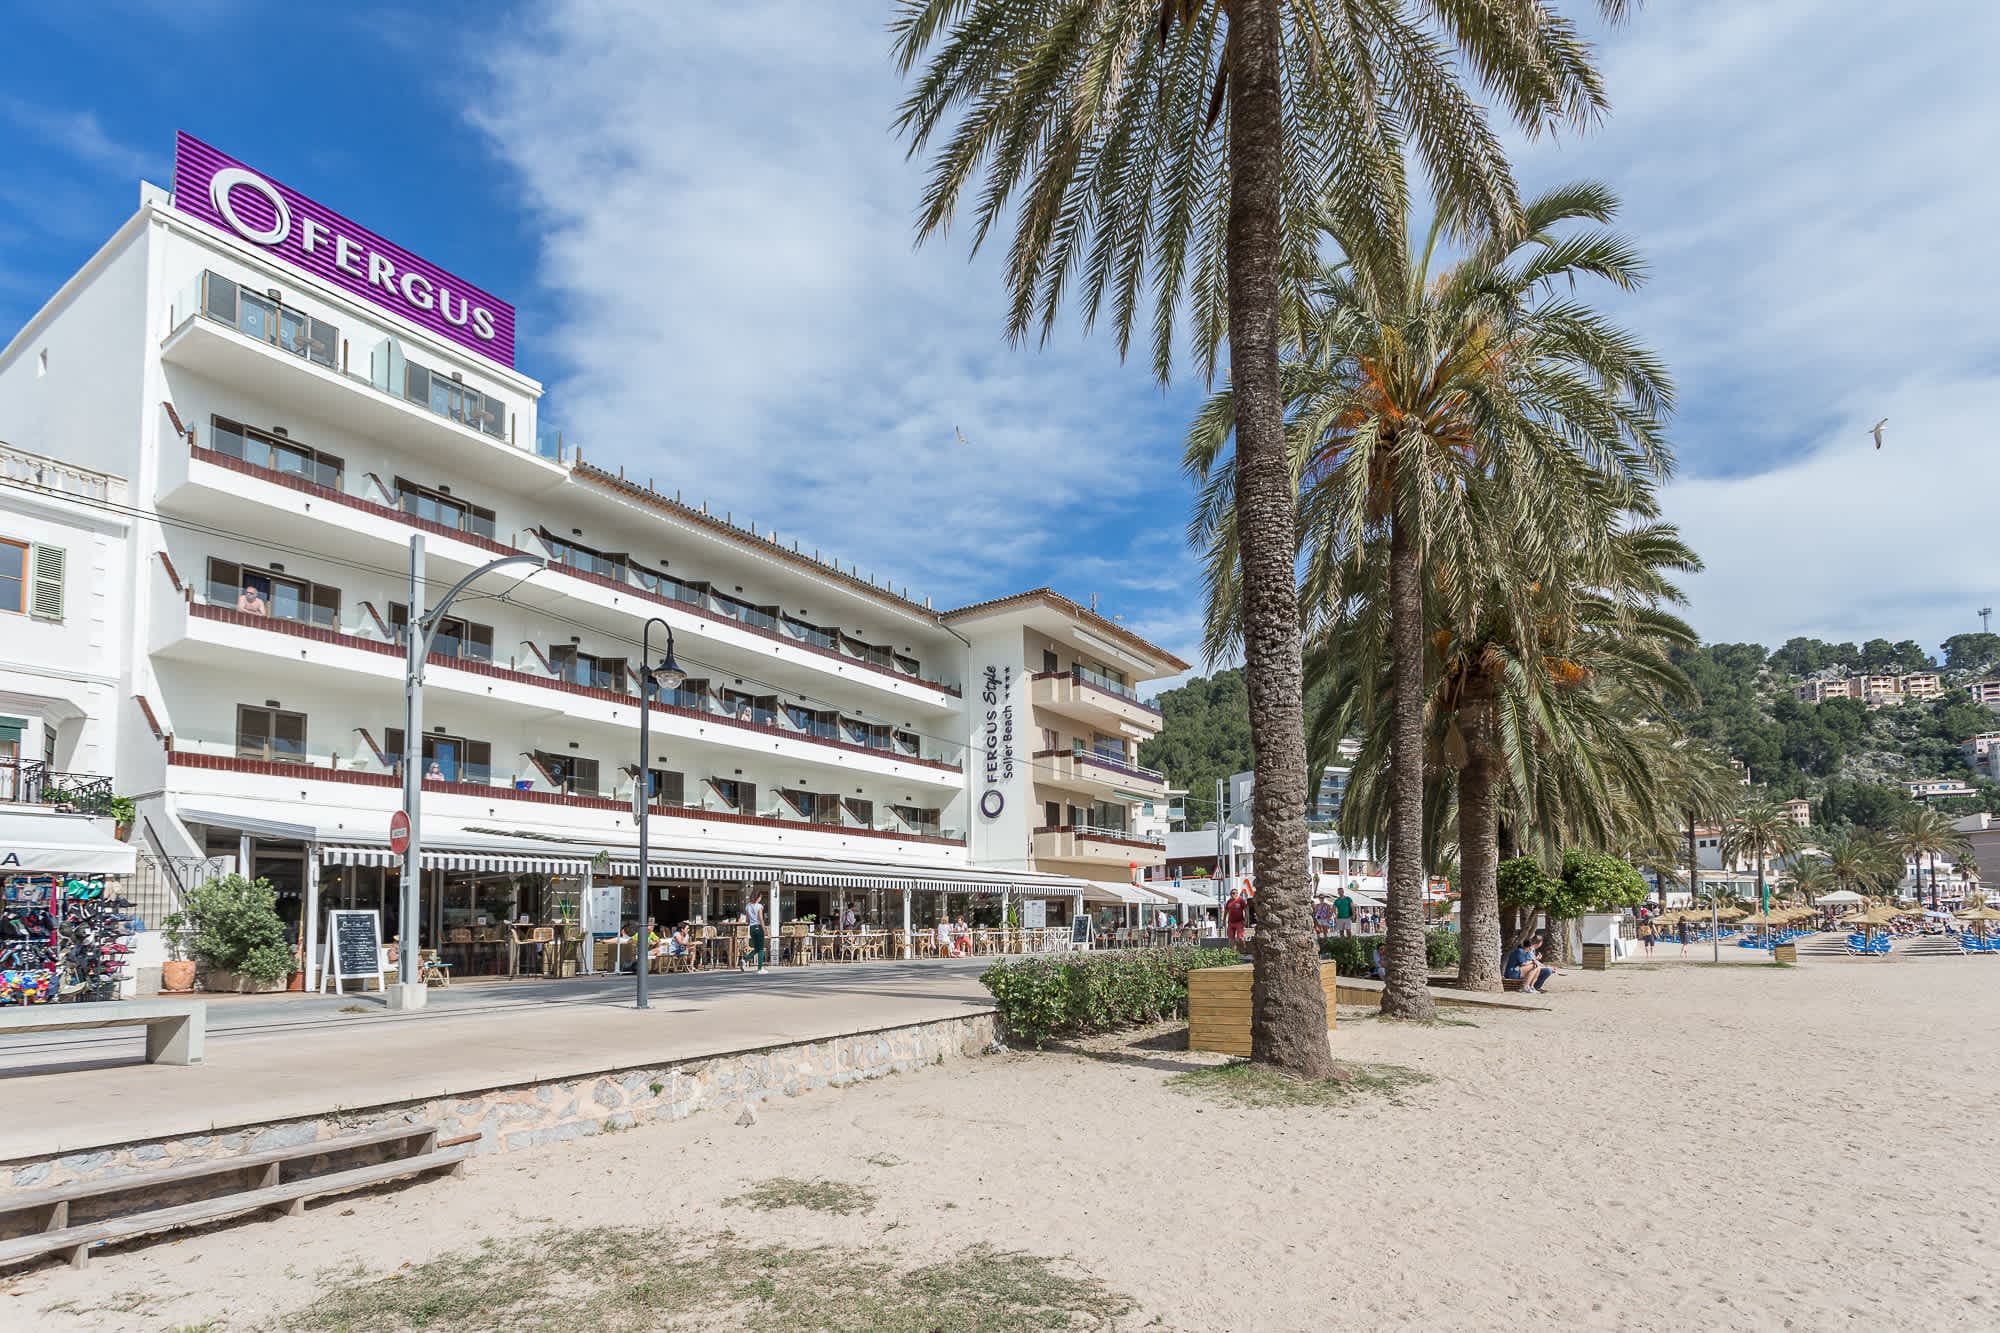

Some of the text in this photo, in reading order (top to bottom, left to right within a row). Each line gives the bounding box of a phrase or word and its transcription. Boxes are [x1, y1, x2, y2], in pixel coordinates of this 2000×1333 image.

[302, 217, 496, 341] FERGUS
[982, 665, 1003, 783] FERGUS Style
[1002, 705, 1014, 779] Soller Beach
